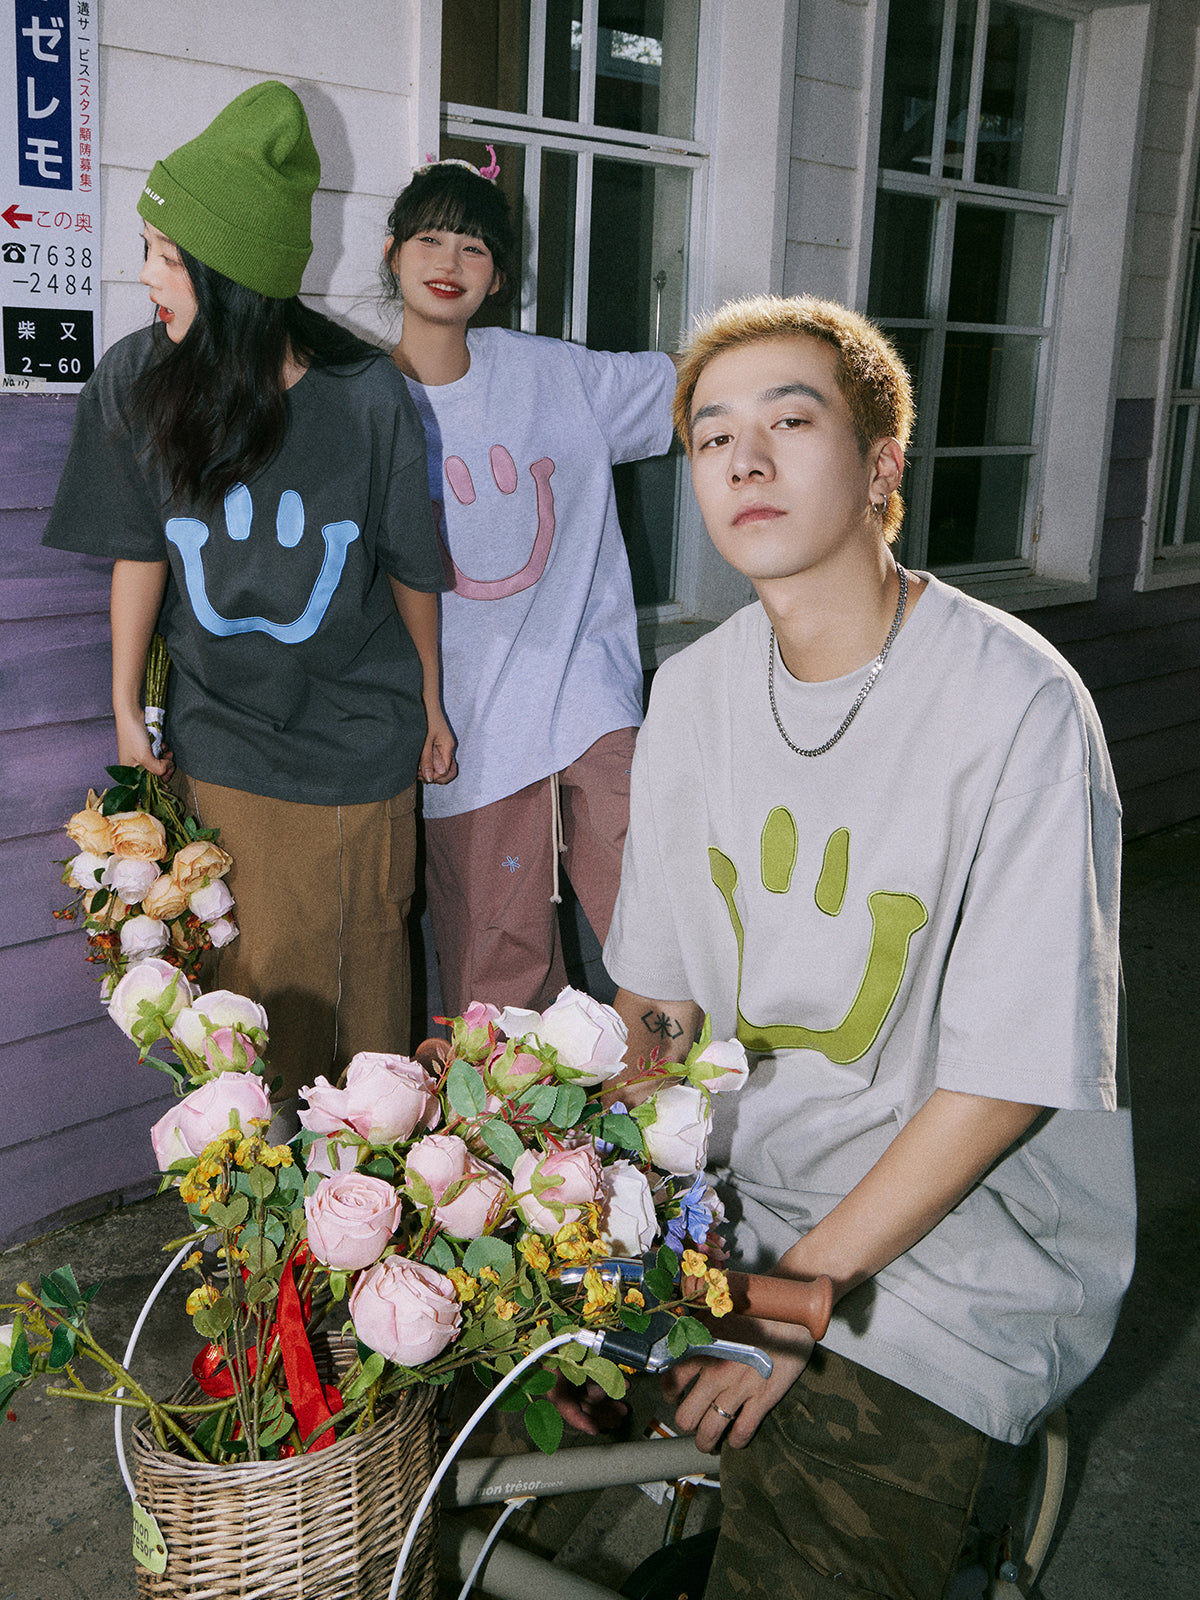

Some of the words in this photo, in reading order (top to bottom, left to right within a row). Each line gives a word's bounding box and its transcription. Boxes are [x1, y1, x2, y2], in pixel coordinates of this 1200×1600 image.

[21, 0, 65, 180] ゼレモ
[36, 210, 93, 234] この奥
[30, 243, 92, 268] 7638
[505, 1480, 542, 1494] trésor
